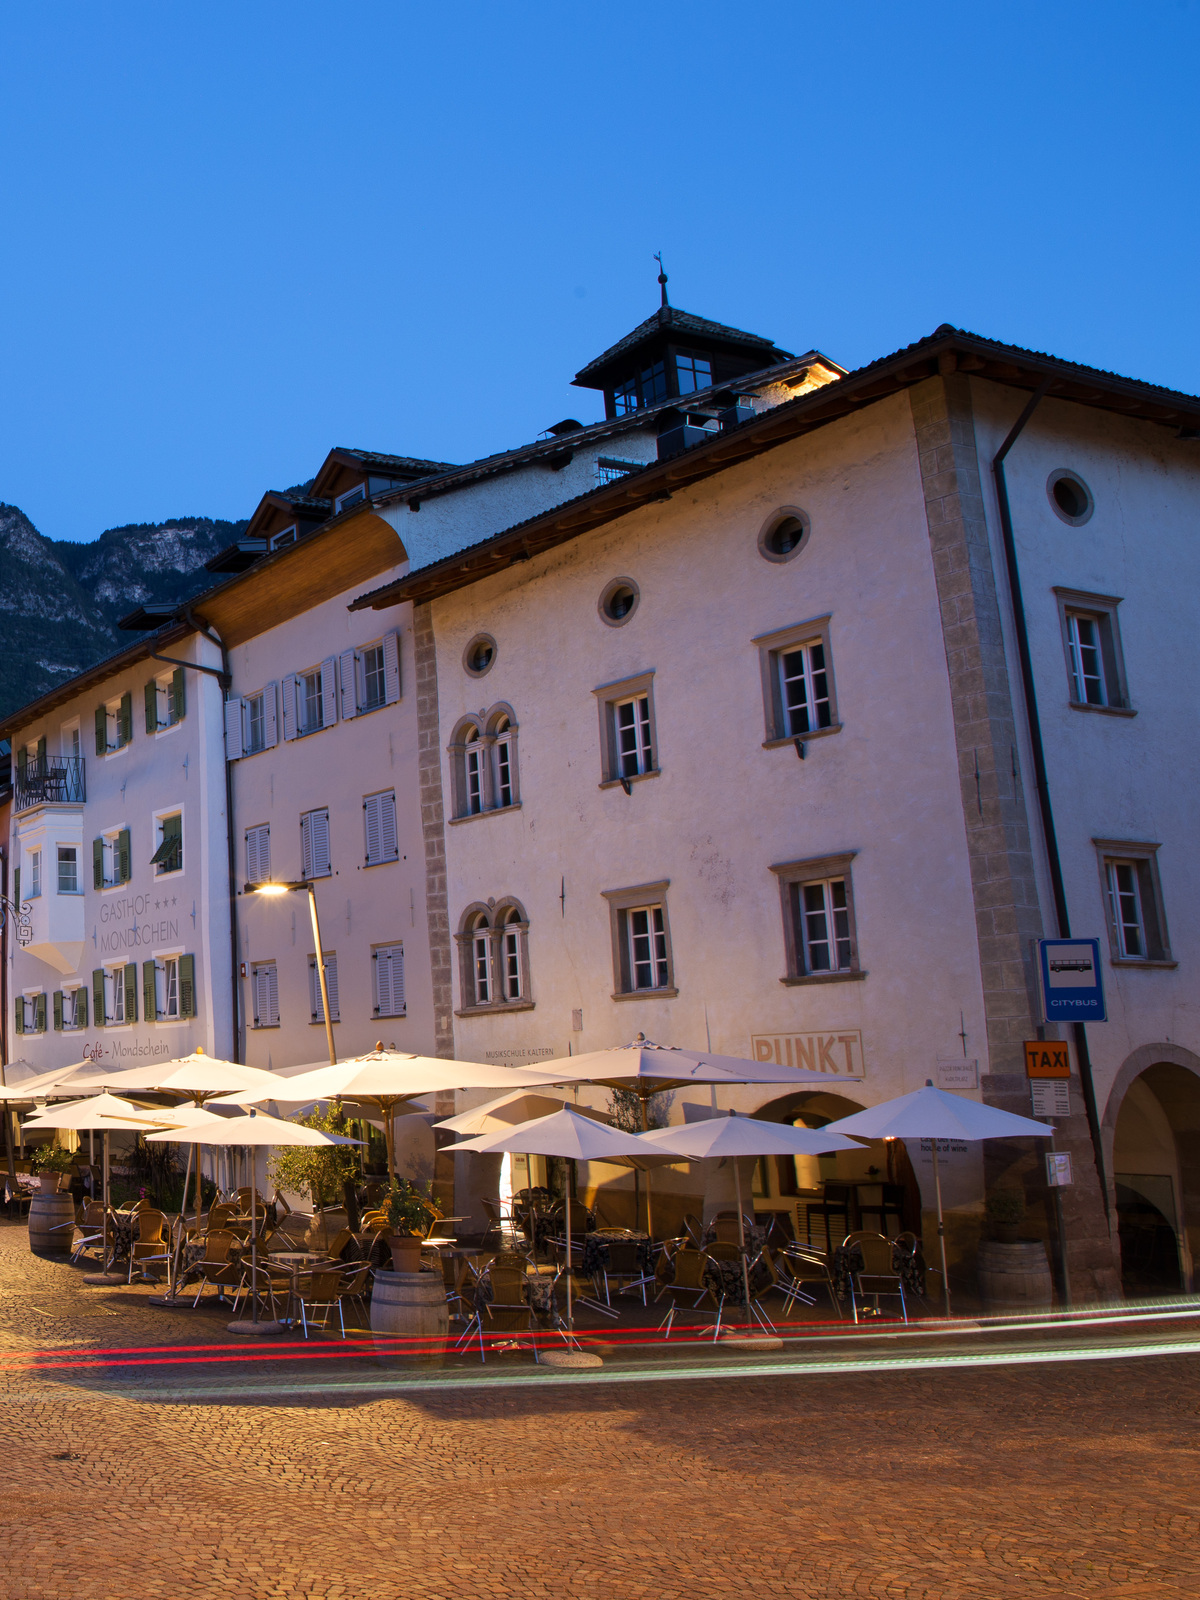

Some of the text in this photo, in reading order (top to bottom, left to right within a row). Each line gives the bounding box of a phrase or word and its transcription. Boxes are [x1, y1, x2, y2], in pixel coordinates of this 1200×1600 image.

[100, 894, 150, 923] GASTHOF
[100, 919, 179, 952] MONDSCHEIN
[1050, 999, 1098, 1007] CITYBUS
[82, 1041, 103, 1062] Café
[112, 1038, 170, 1059] Mondschein
[485, 1048, 554, 1059] MUSIKSCHULE KALTERN
[1028, 1051, 1069, 1068] TAXI
[942, 1143, 950, 1151] of
[951, 1143, 968, 1152] wine
